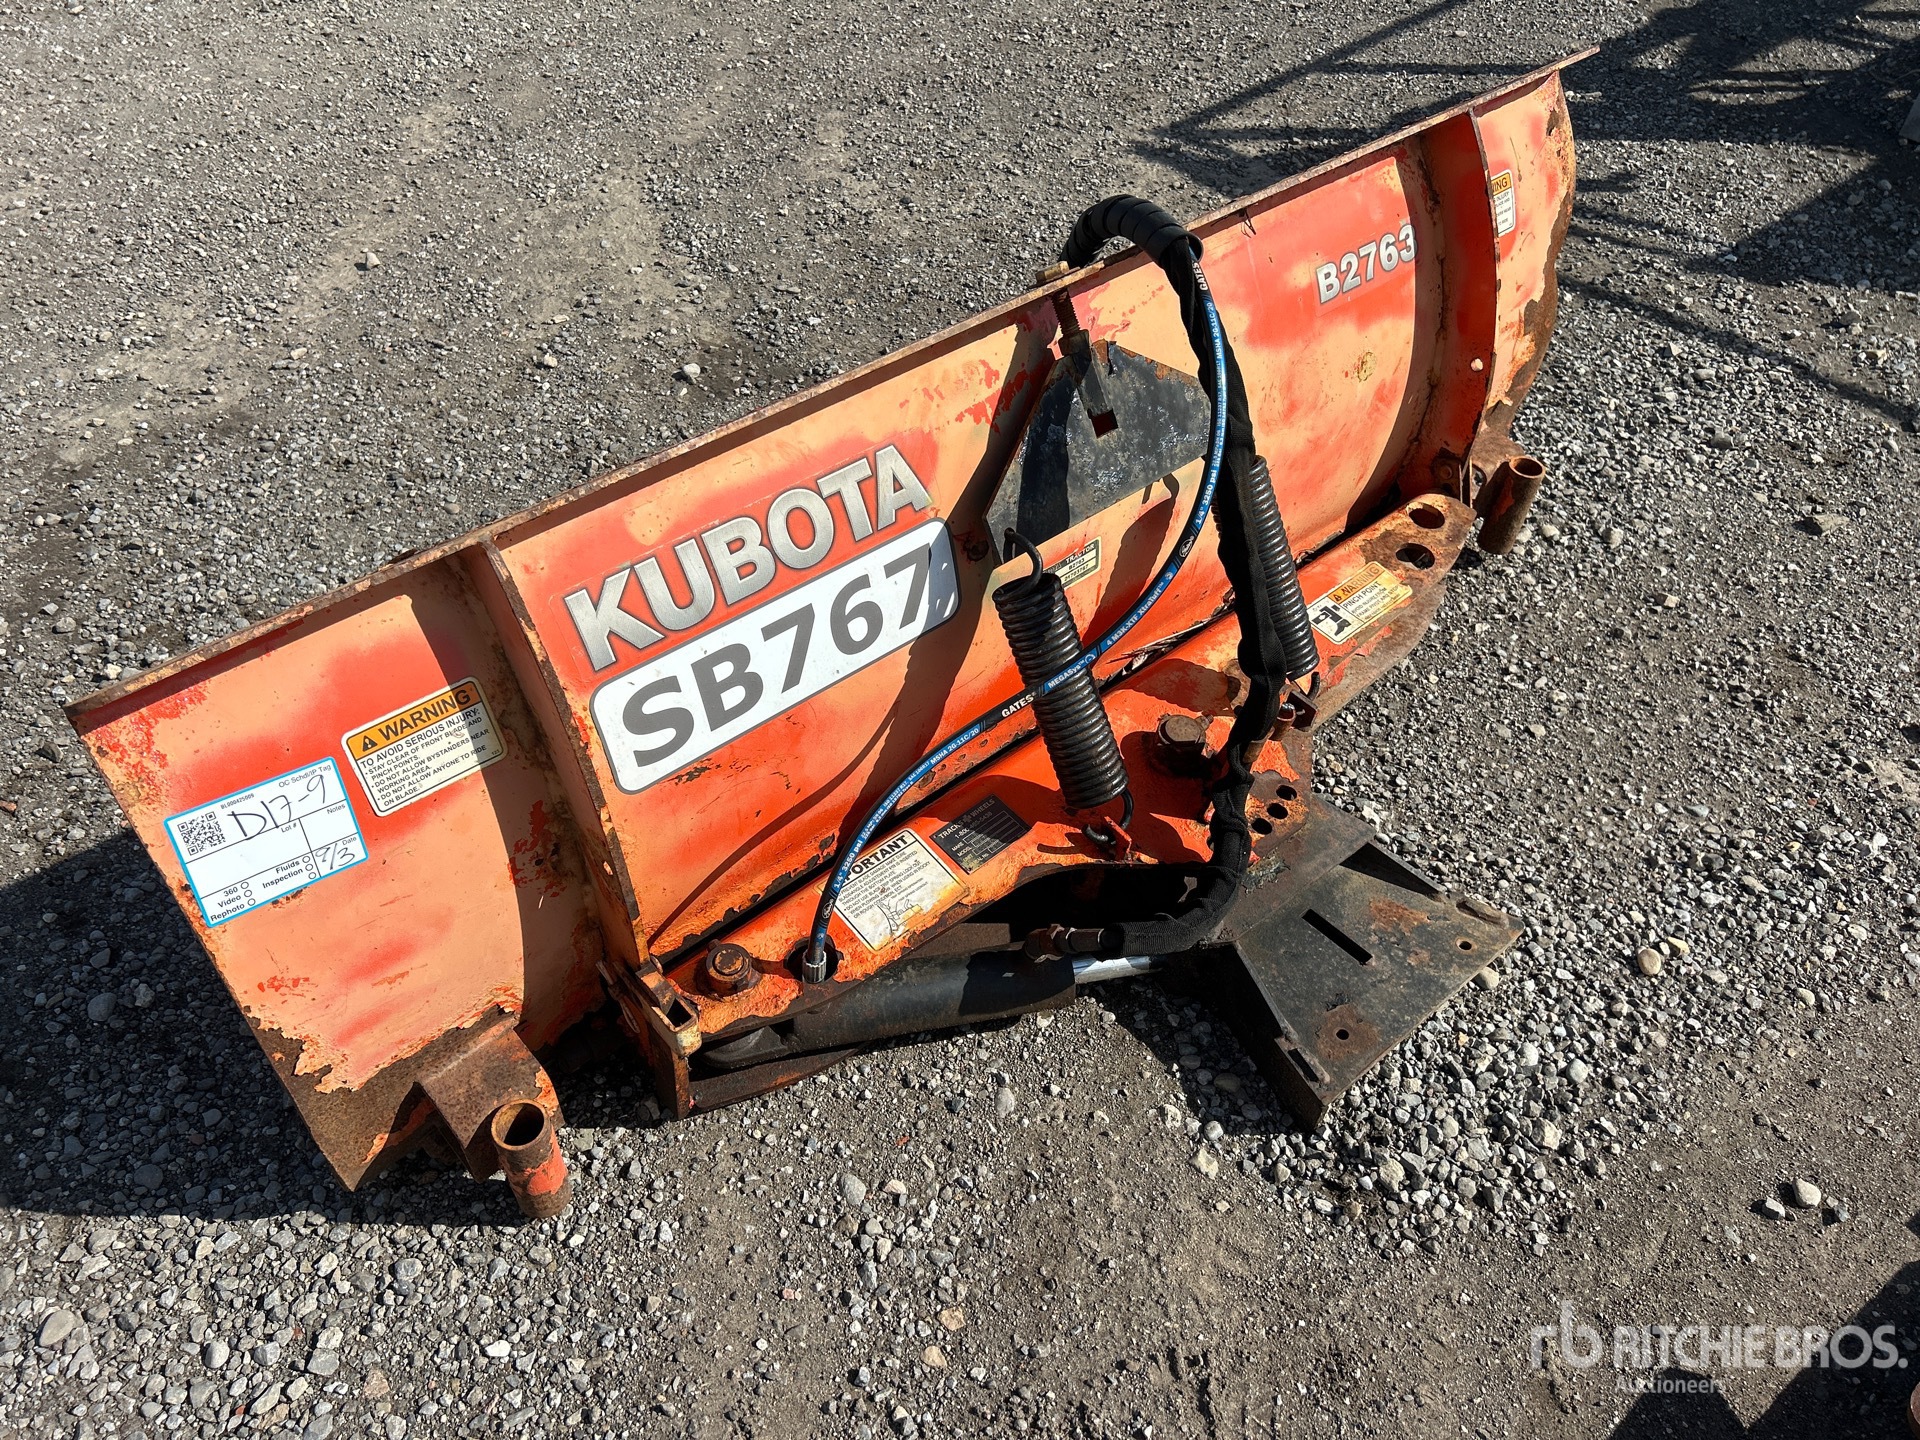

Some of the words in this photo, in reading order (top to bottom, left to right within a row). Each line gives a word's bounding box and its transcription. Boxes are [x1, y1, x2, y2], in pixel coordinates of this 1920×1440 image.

[1316, 224, 1418, 305] B2763
[1215, 339, 1223, 359] MSHA
[1202, 485, 1214, 506] 3250
[1210, 469, 1218, 483] psi
[564, 444, 933, 672] KUBOTA
[1343, 593, 1362, 608] PINCH
[1362, 581, 1380, 595] POINT
[622, 542, 932, 768] SB767
[379, 690, 470, 739] WARNING
[361, 758, 374, 767] TO
[375, 744, 403, 761] AVOID
[405, 724, 444, 746] SERIOUS
[446, 708, 479, 727] INJURY:
[368, 763, 385, 773] STAY
[386, 751, 409, 765] CLEAR
[421, 735, 443, 748] FRONT
[444, 724, 466, 737] BLADE
[467, 717, 482, 726] AND
[371, 767, 392, 780] PINCH
[393, 754, 420, 769] POINTS.
[386, 772, 400, 781] NOT
[401, 759, 425, 773] ALLOW
[426, 738, 469, 760] BYSTANDERS
[471, 729, 489, 740] NEAR
[930, 749, 948, 765] MSHA
[278, 780, 290, 788] OC
[319, 764, 331, 774] Tag
[377, 775, 410, 792] WORKING
[411, 764, 431, 776] AREA.
[392, 784, 406, 793] NOT
[407, 772, 431, 786] ALLOW
[432, 758, 459, 773] ANYONE
[470, 745, 486, 755] RIDE
[395, 786, 419, 800] BLADE.
[327, 804, 346, 814] Notes
[970, 799, 994, 816] WHEELS
[281, 825, 292, 833] Lot
[342, 836, 357, 846] Date
[275, 860, 300, 874] Fluids
[842, 852, 856, 871] 3250
[854, 840, 863, 852] psi
[844, 835, 908, 882] PORTANT
[224, 886, 238, 897] 360
[262, 868, 303, 889] Inspection
[210, 903, 245, 922] Rephoto
[218, 895, 242, 908] Video
